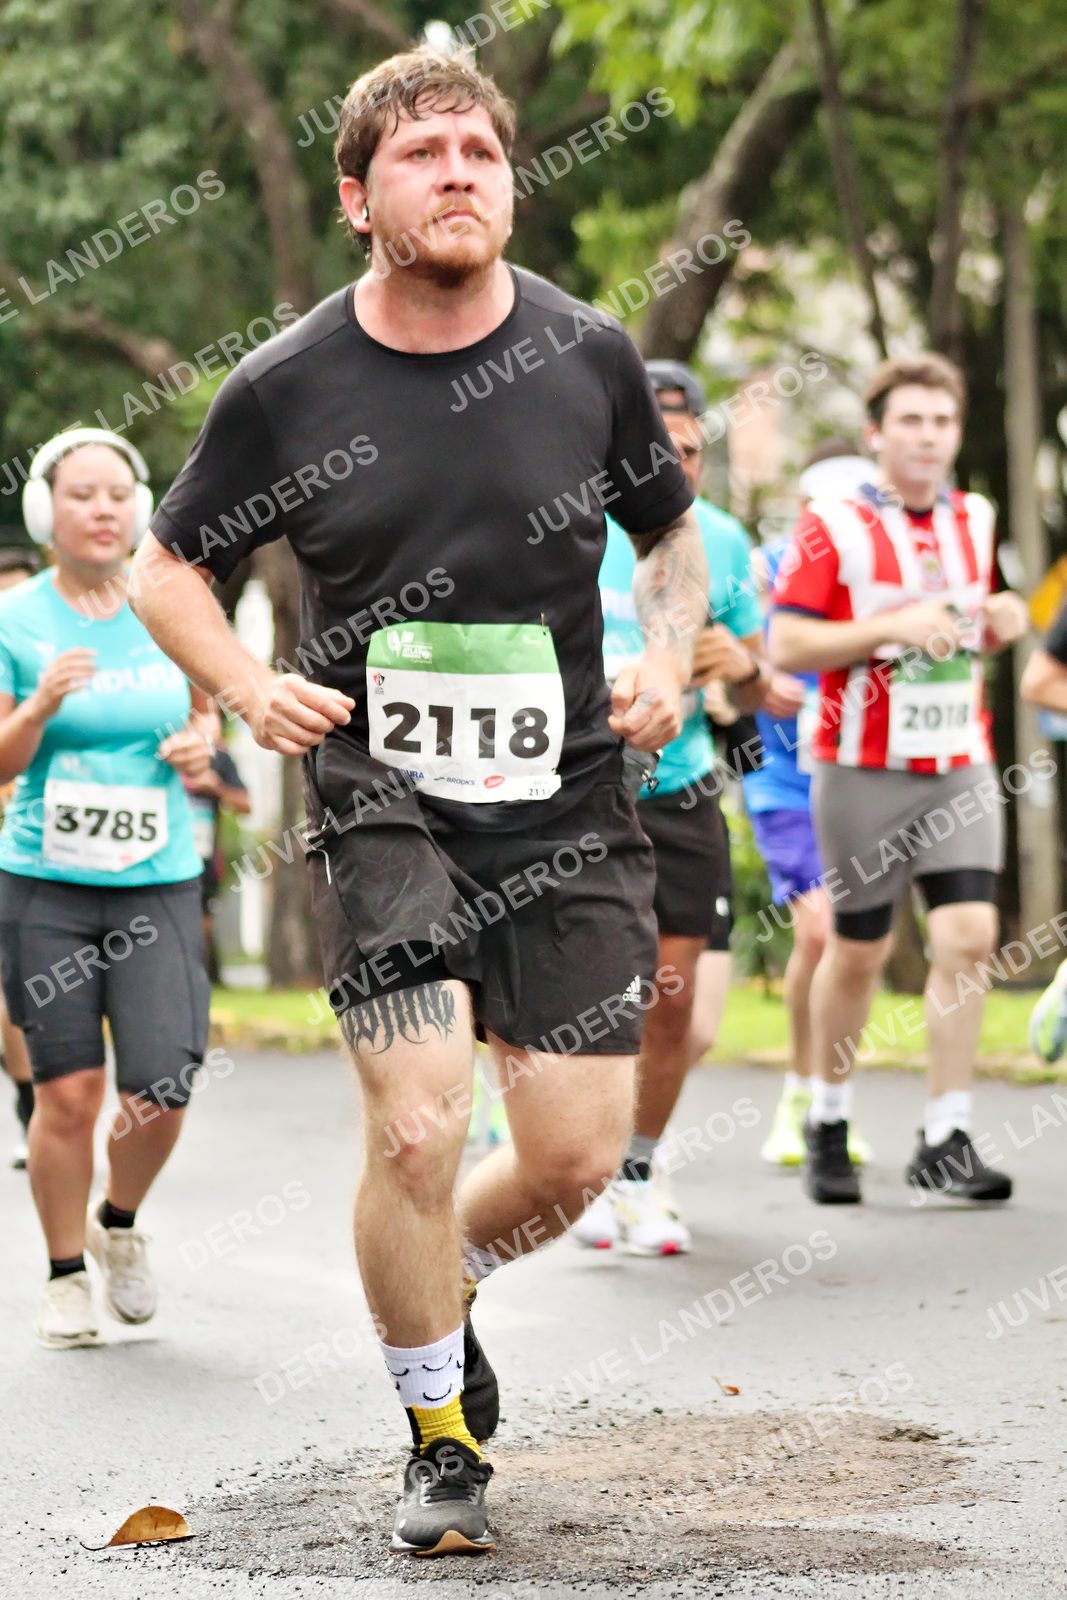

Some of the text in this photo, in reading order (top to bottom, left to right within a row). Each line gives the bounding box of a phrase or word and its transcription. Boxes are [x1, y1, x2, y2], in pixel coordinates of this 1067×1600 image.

[382, 701, 550, 760] 2118
[446, 776, 476, 787] BROOKS
[528, 787, 551, 798] 211
[55, 804, 158, 842] 3785
